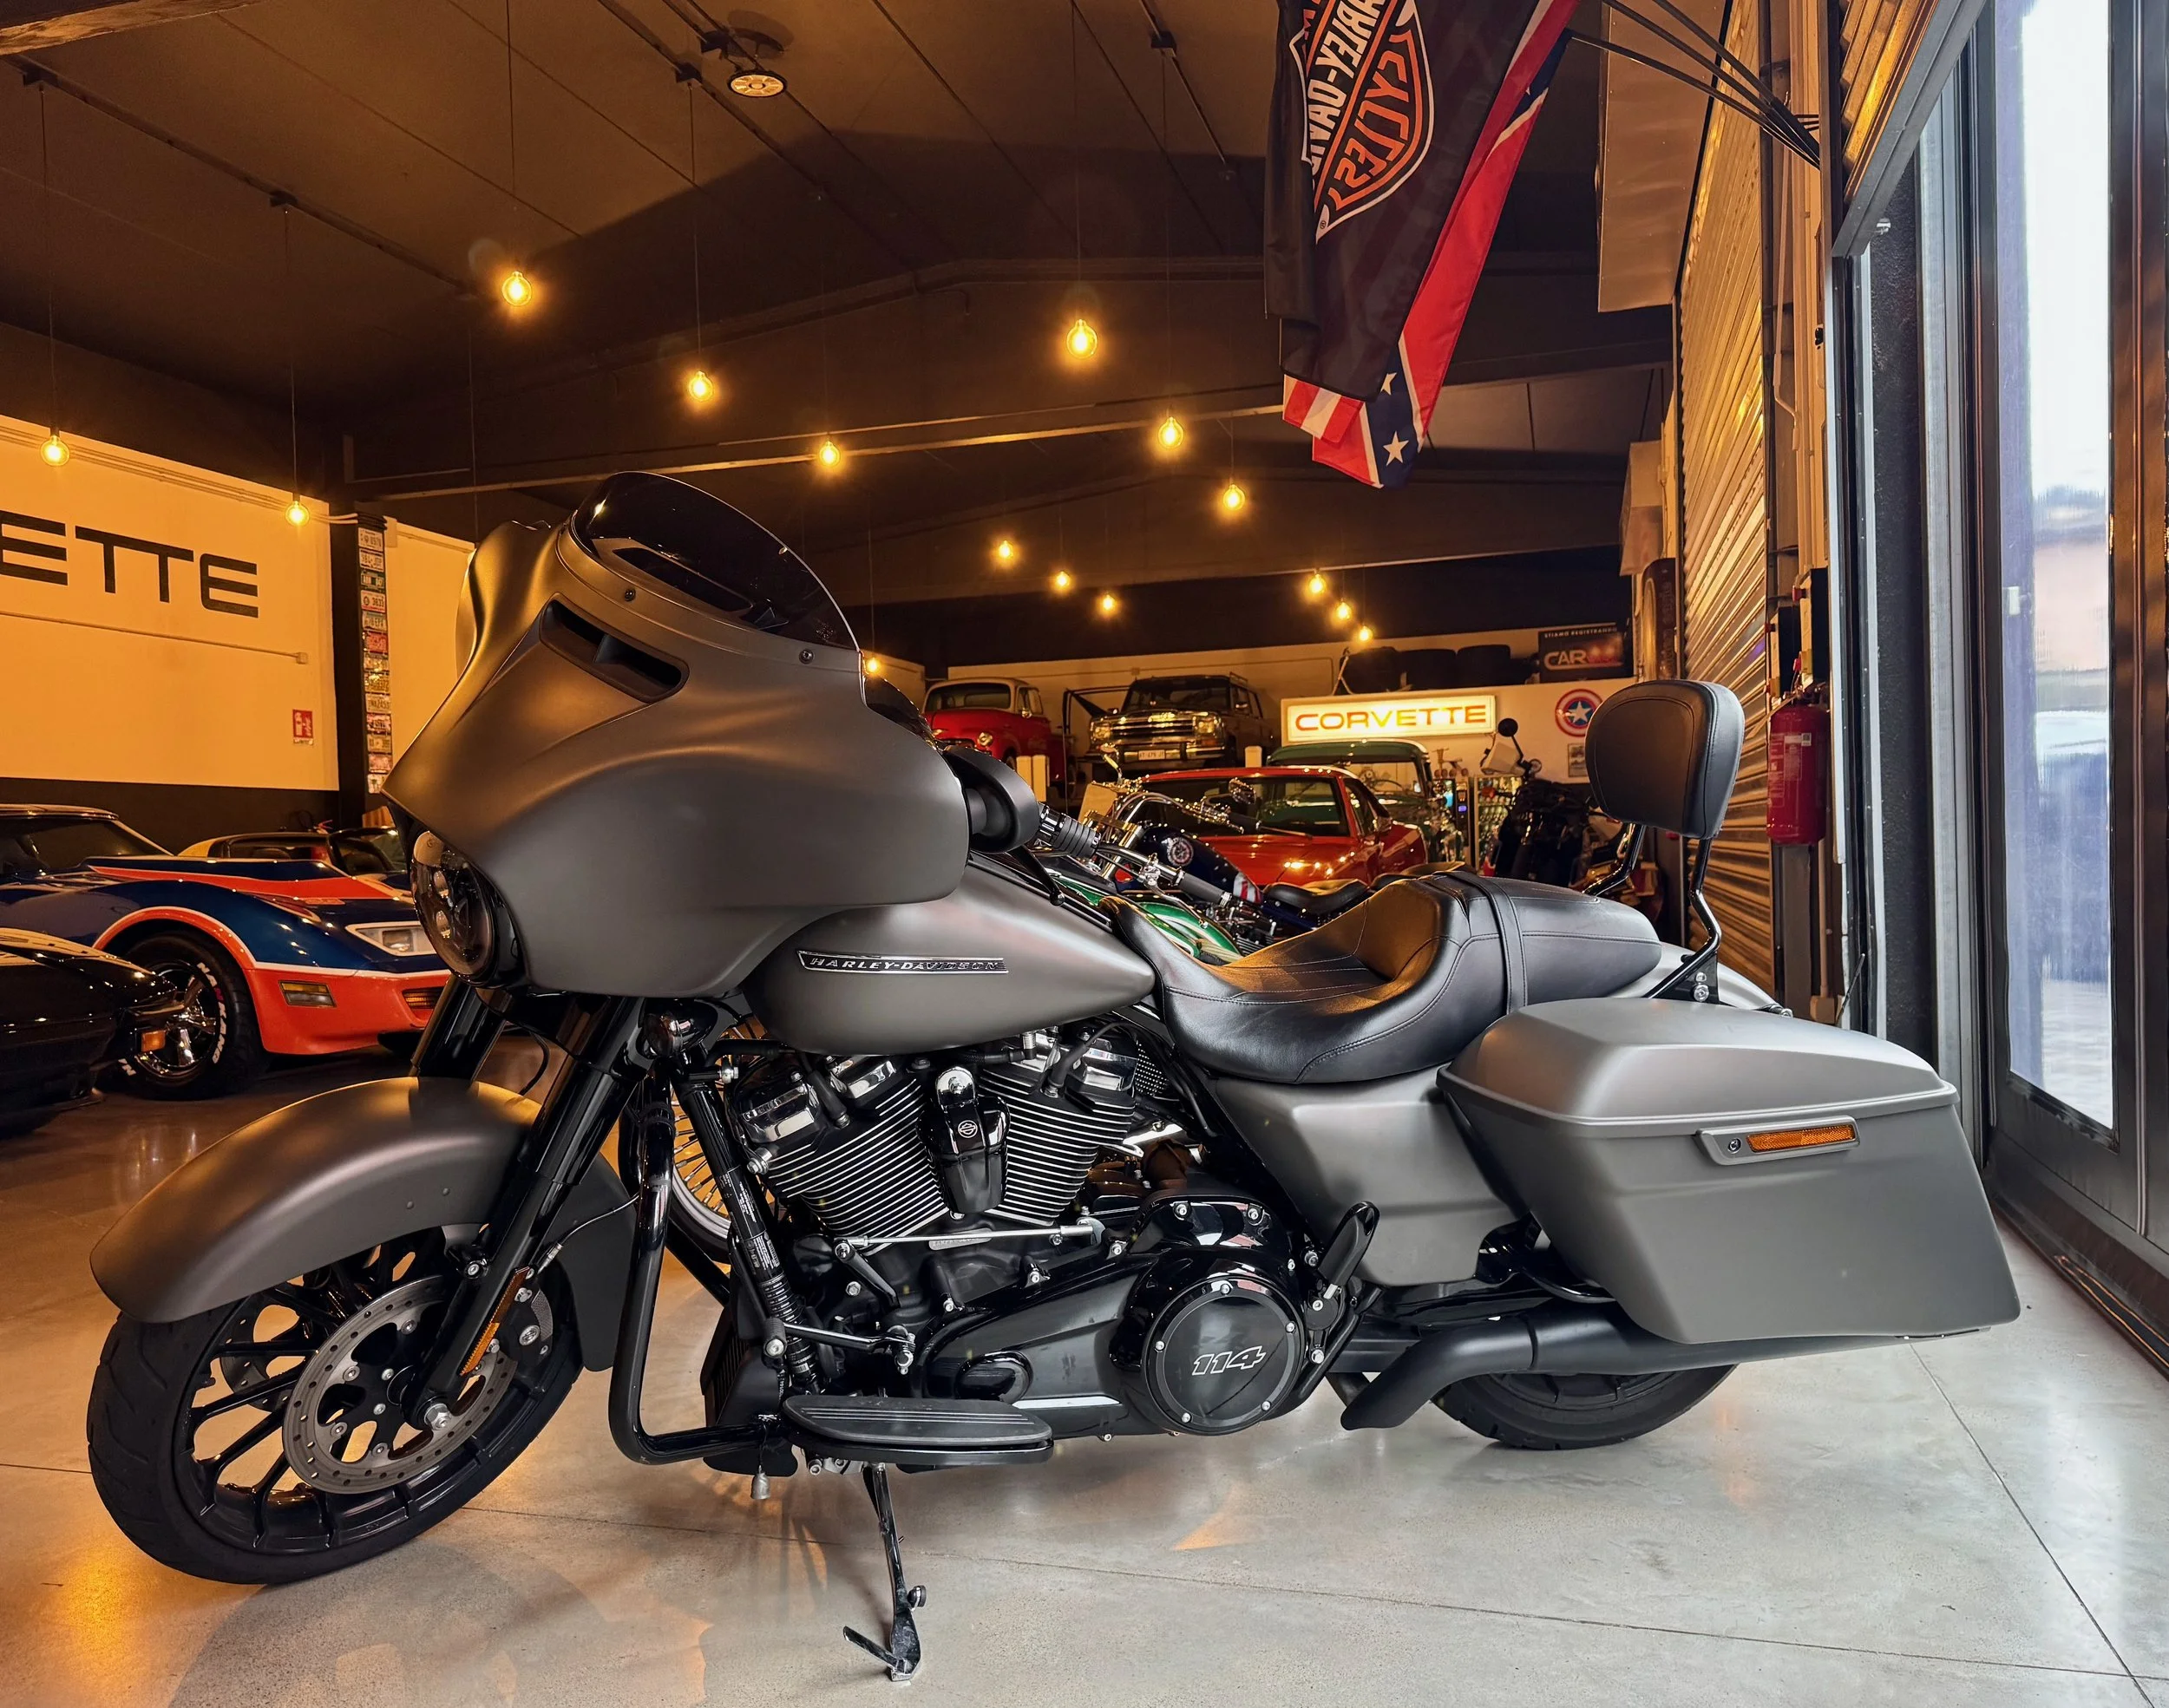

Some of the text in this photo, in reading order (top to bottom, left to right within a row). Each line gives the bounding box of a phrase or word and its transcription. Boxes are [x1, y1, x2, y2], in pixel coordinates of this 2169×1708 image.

[1295, 704, 1486, 731] CORVETTE
[810, 957, 999, 971] HARLEY-DAVIDSON
[1192, 1345, 1267, 1376] 114
